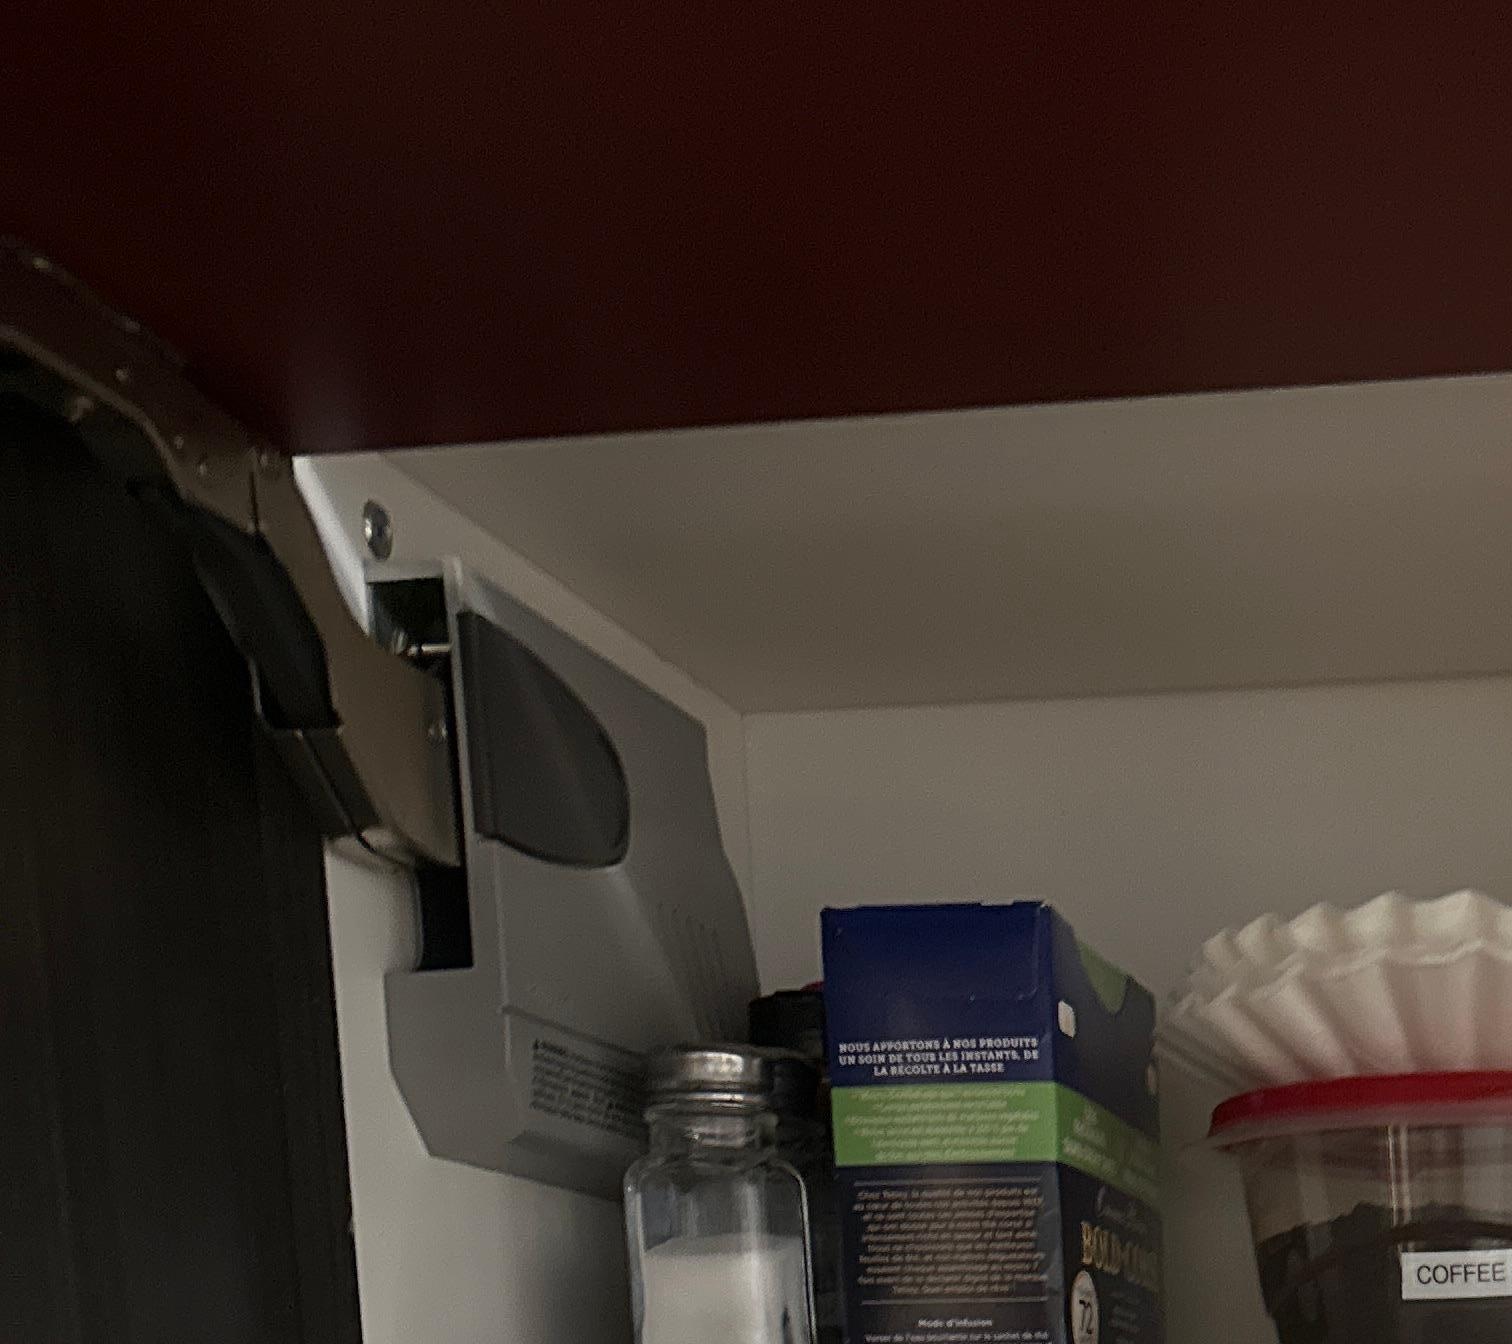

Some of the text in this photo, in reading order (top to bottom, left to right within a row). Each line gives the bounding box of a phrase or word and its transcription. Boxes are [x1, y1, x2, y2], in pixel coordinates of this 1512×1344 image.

[838, 1042, 870, 1054] NOUS
[873, 1040, 940, 1052] APPORTONS
[953, 1038, 977, 1049] NOS
[979, 1037, 1038, 1049] PRODUITS
[838, 1054, 856, 1066] UN
[858, 1053, 886, 1065] SOIN
[888, 1052, 903, 1063] DE
[905, 1051, 936, 1063] TOUS
[938, 1050, 958, 1062] LES
[1023, 1049, 1039, 1060] DE
[873, 1065, 889, 1077] LA
[953, 1062, 968, 1074] LA
[969, 1061, 1005, 1073] TASSE
[1417, 1263, 1505, 1285] COFFEE
